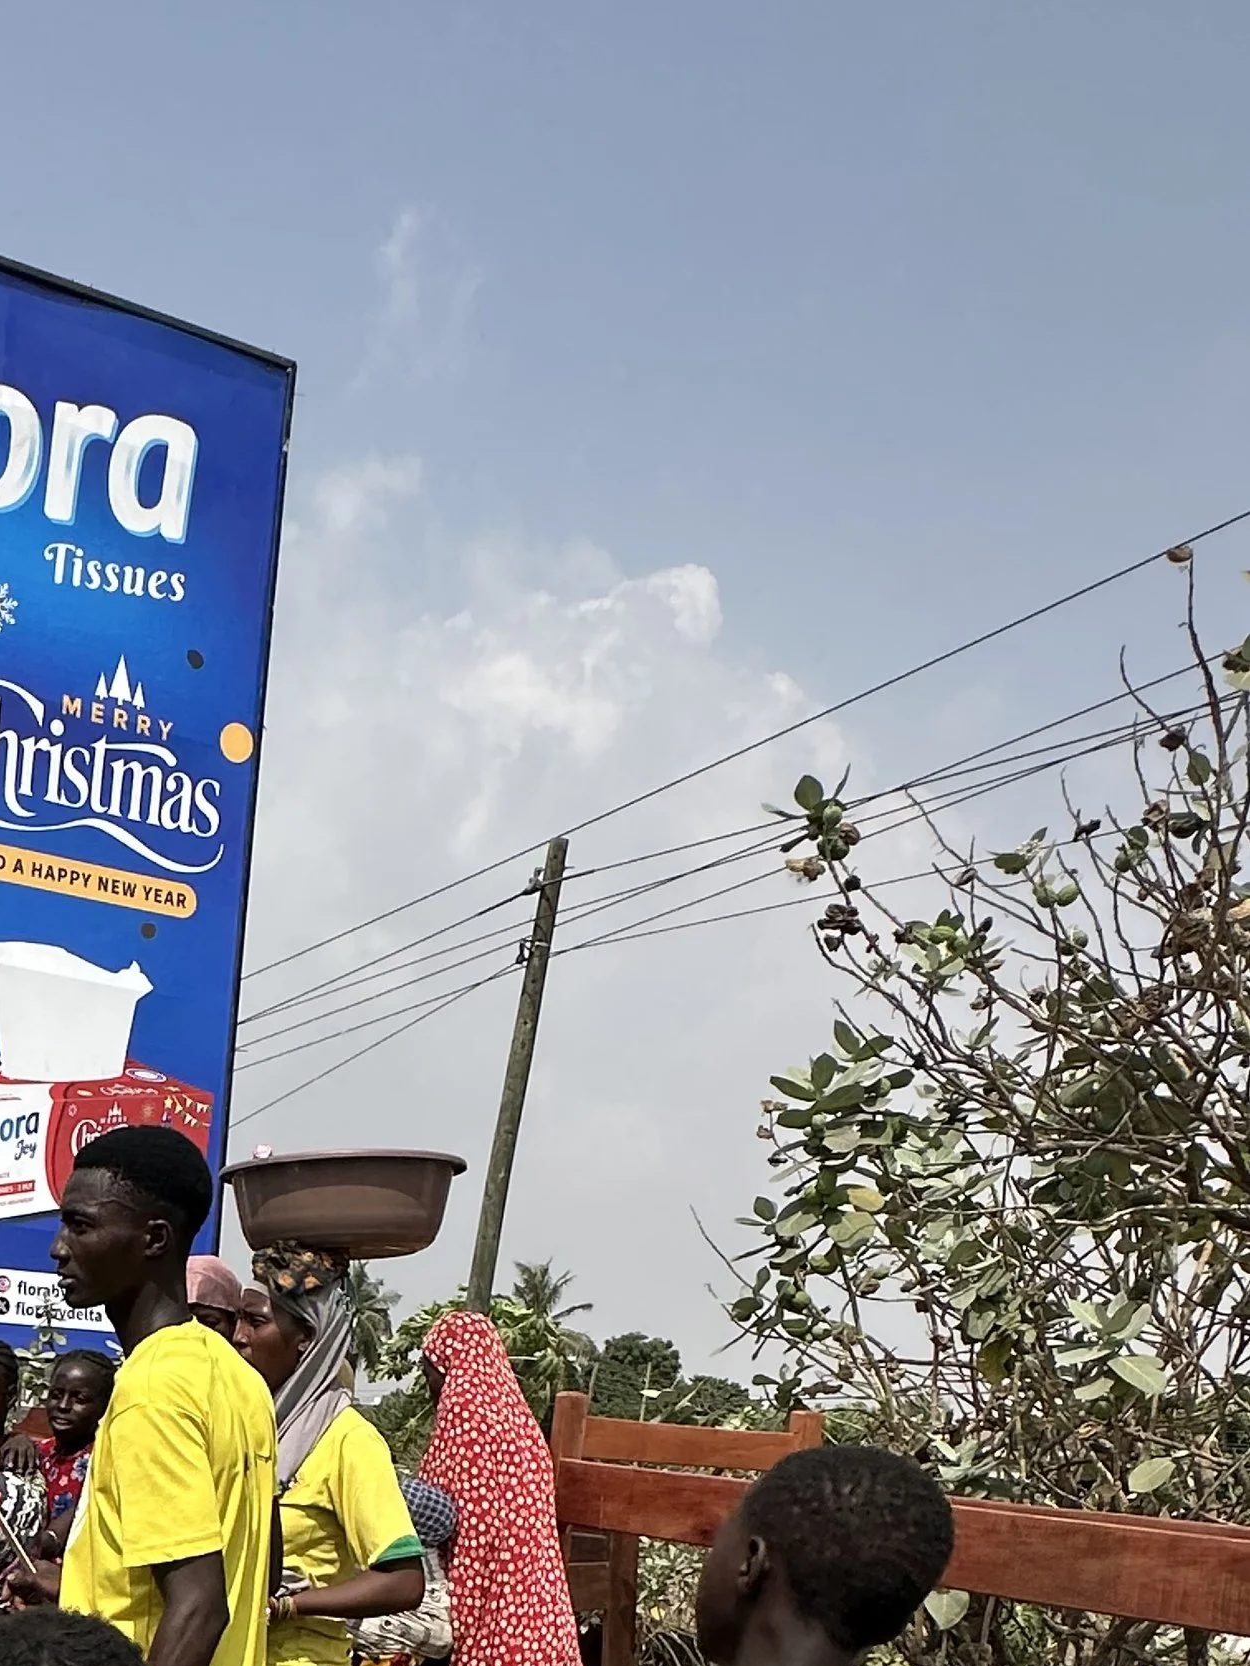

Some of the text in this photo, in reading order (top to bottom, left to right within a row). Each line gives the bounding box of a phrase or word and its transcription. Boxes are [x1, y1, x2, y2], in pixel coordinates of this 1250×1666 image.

[43, 541, 186, 602] Tissues
[61, 694, 174, 741] MERRY
[12, 860, 25, 875] A
[31, 863, 92, 889] HAPPY
[97, 877, 137, 898] NEW
[142, 885, 187, 909] YEAR
[14, 1139, 38, 1161] Joy
